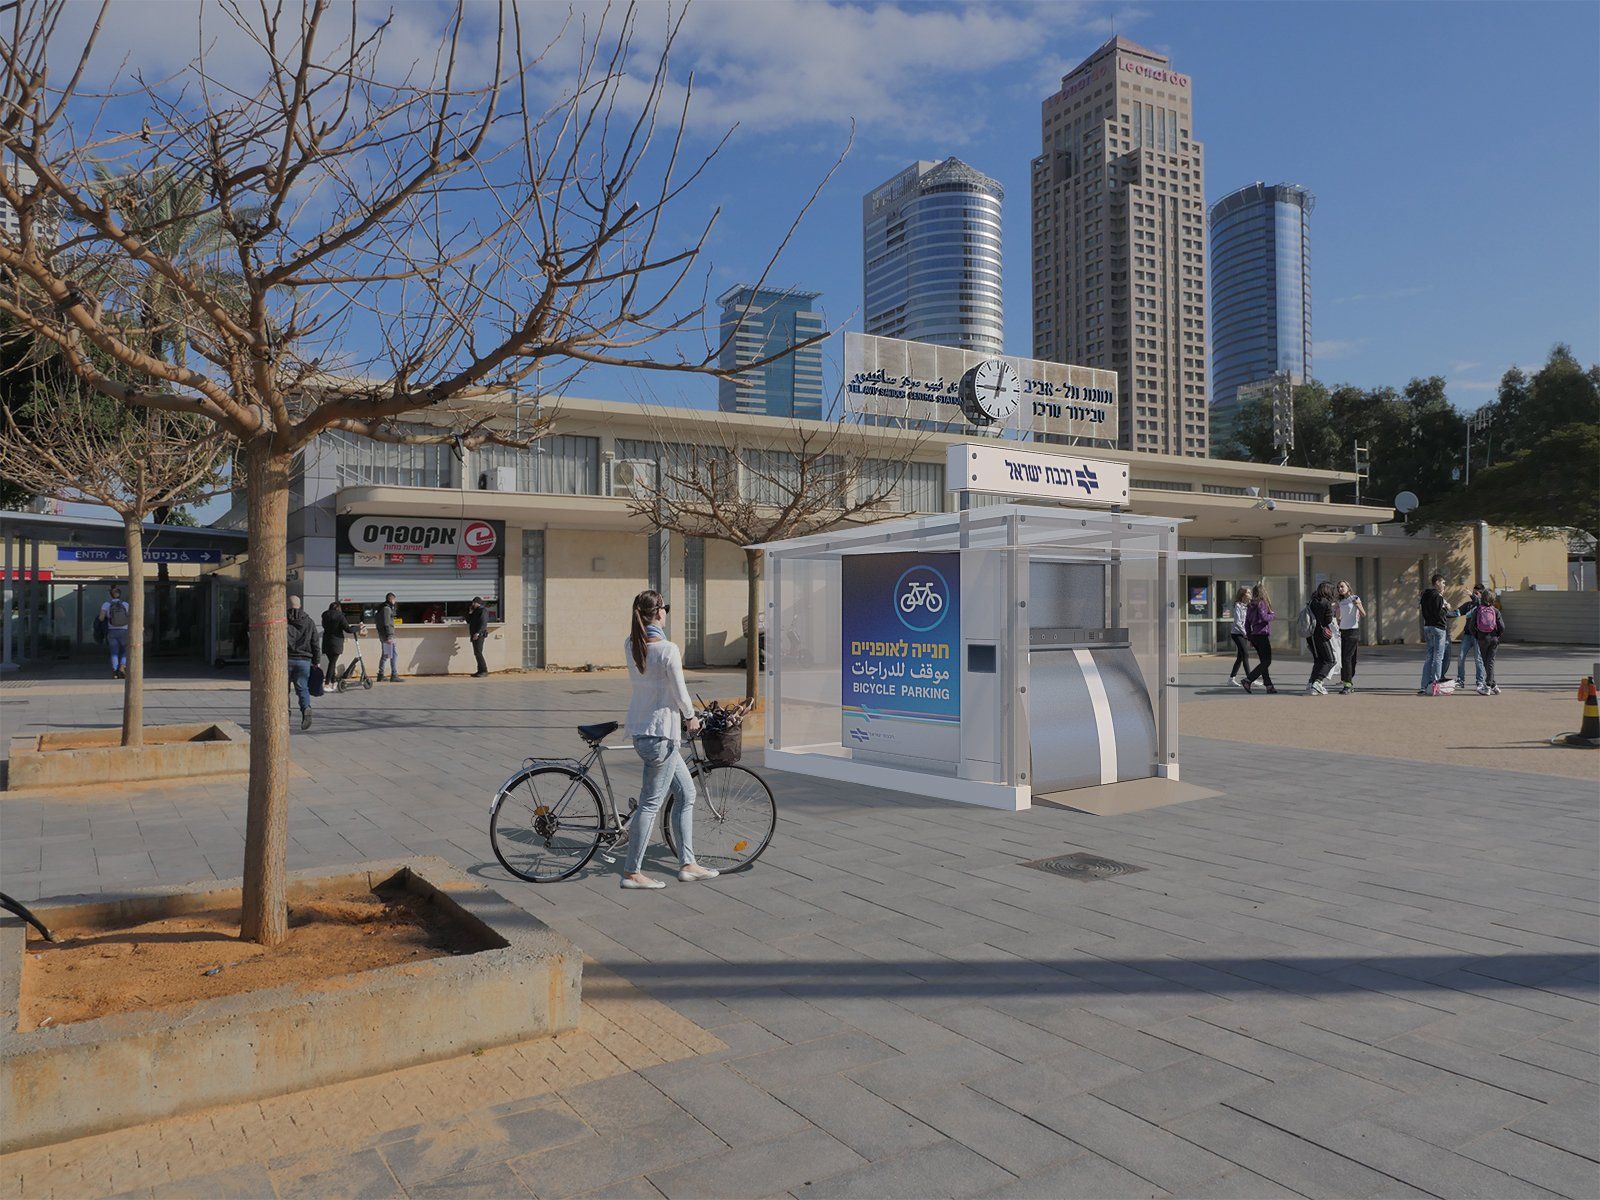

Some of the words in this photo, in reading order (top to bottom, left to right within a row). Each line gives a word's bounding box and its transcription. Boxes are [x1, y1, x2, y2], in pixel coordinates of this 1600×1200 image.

[847, 384, 863, 393] TEL
[1005, 459, 1042, 482] ישראל
[1045, 466, 1074, 486] רכבת
[363, 524, 457, 548] אקספרס
[76, 551, 109, 559] ENTRY
[851, 639, 908, 656] לאופניים
[912, 643, 950, 659] חנייה
[851, 660, 905, 680] للدراجات
[910, 663, 950, 684] موقف
[853, 683, 896, 696] BICYCLE
[901, 685, 950, 700] PARKING
